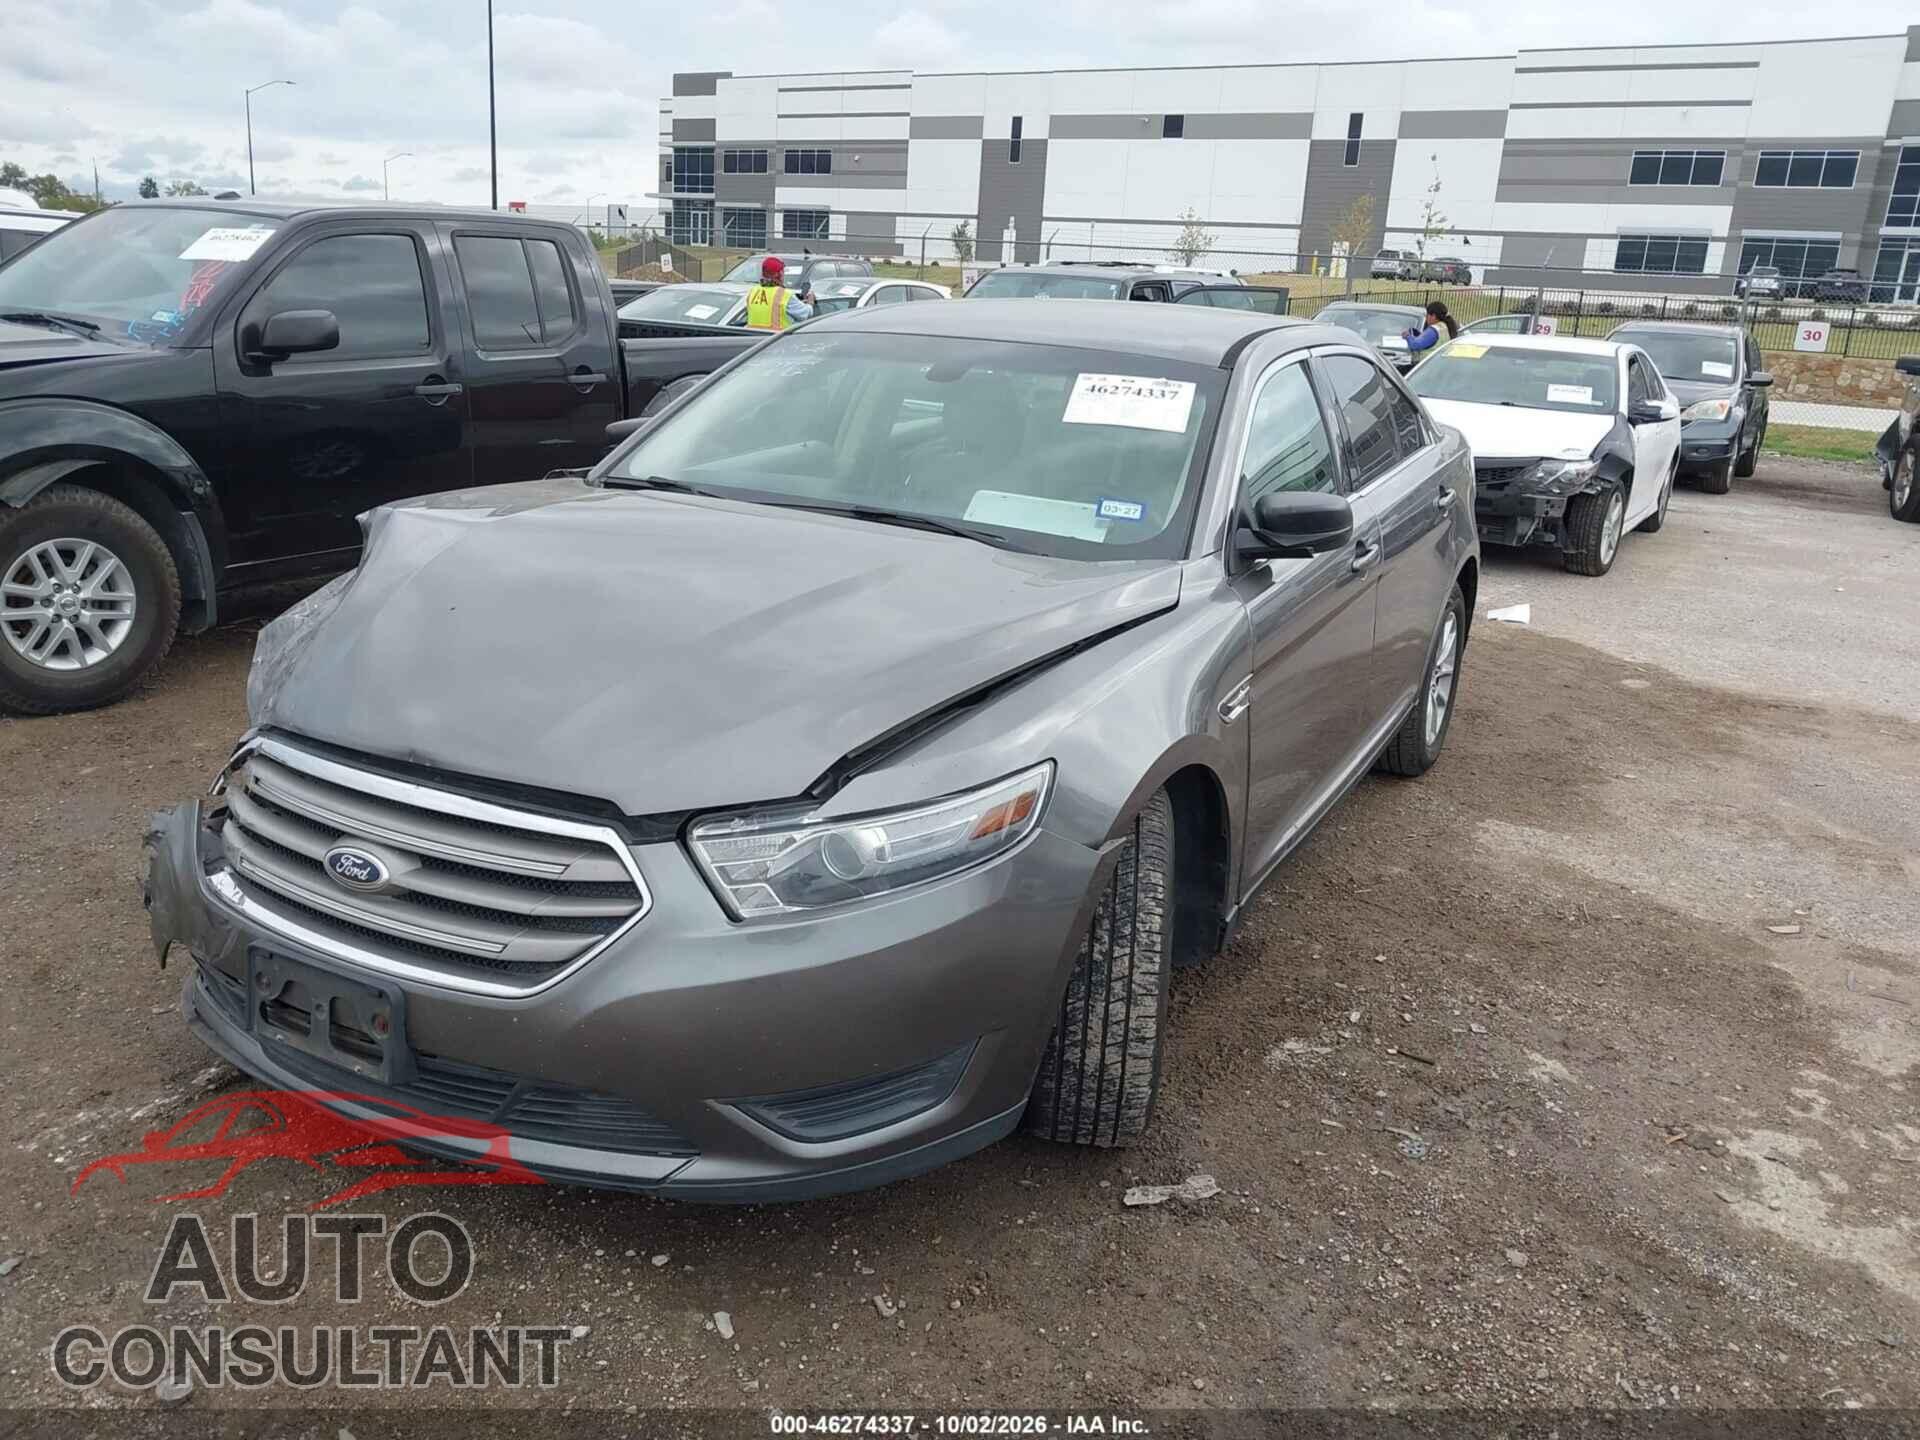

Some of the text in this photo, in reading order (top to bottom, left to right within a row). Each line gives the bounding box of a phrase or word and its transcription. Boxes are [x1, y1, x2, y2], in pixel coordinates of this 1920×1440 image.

[1536, 324, 1551, 335] 29
[1802, 330, 1822, 342] 30
[1085, 384, 1179, 400] 46274337
[336, 854, 371, 880] Ford
